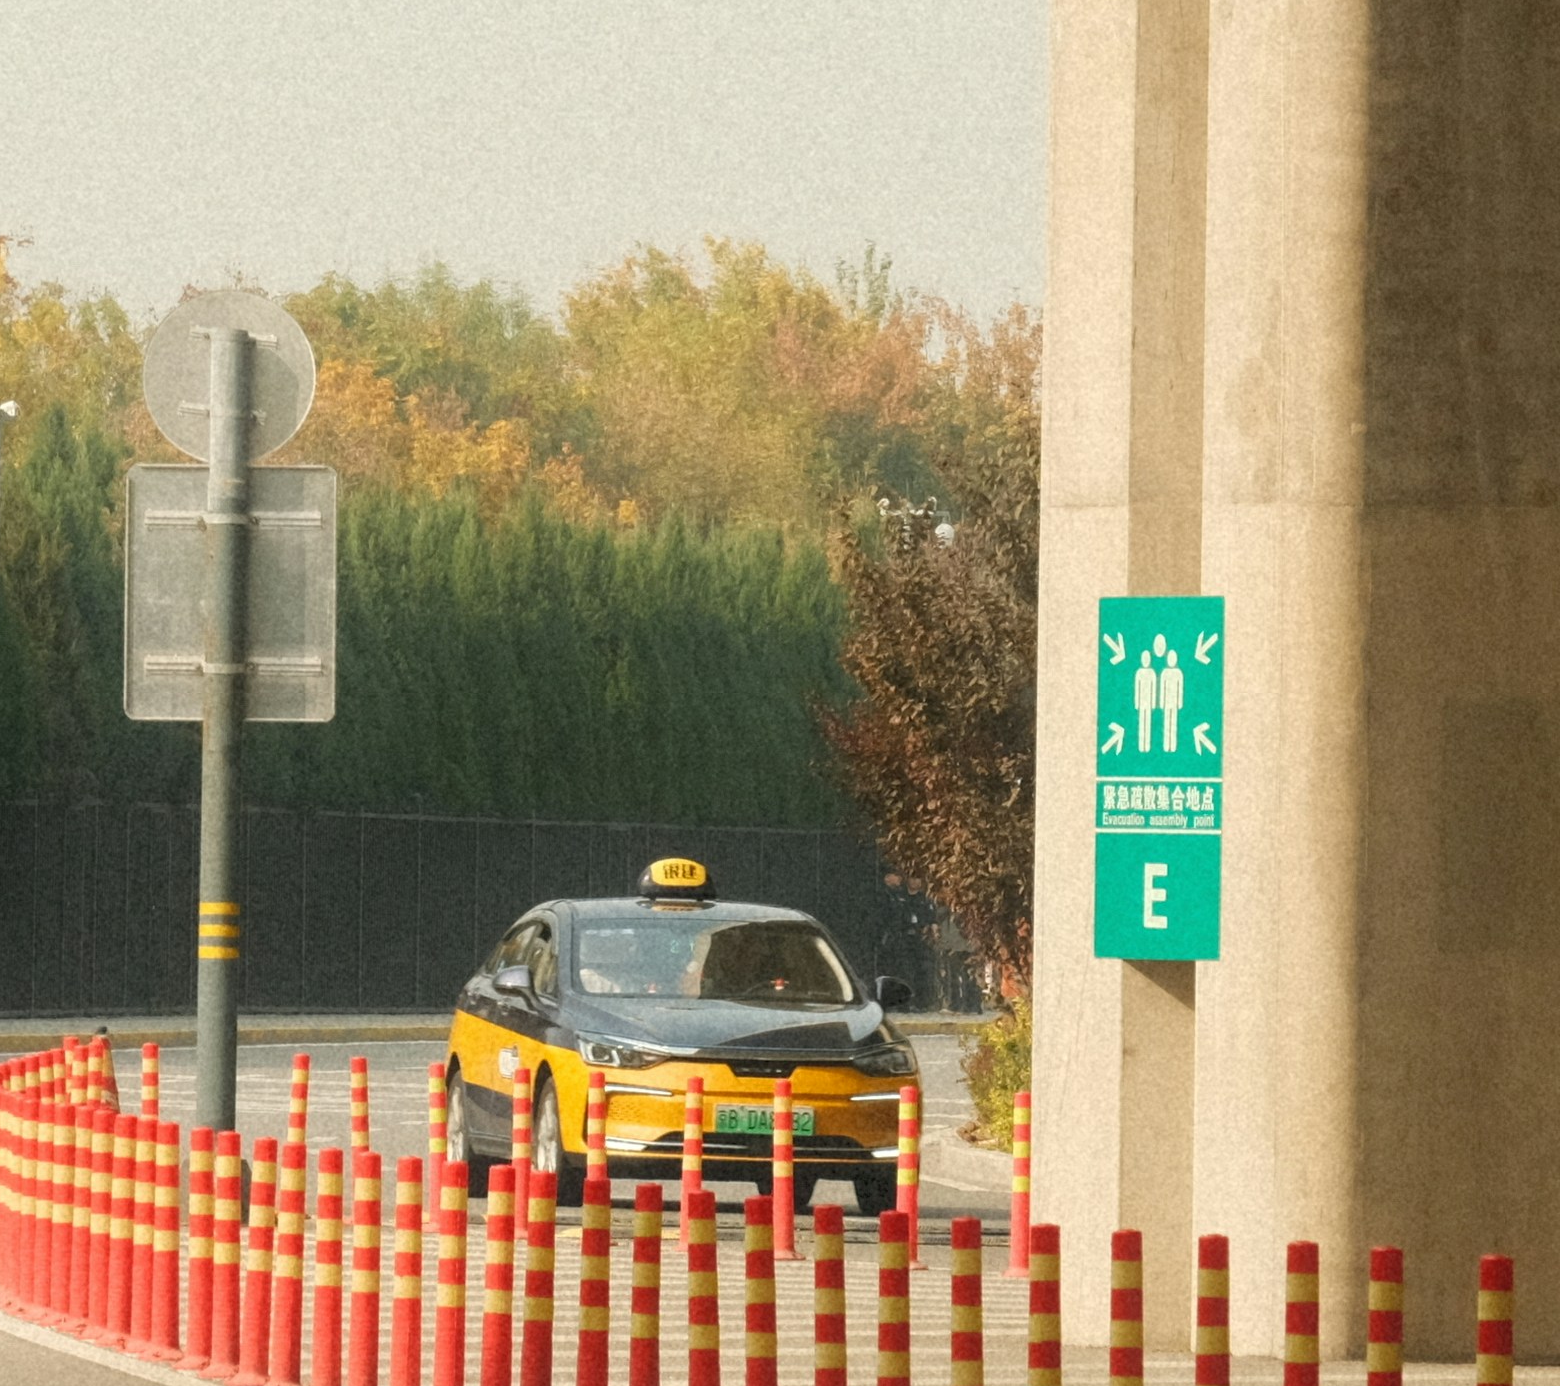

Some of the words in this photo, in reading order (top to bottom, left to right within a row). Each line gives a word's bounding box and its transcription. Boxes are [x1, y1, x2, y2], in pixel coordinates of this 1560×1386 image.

[1103, 785, 1215, 811] 紧急疏散集合地点
[1102, 812, 1145, 826] Evacuation
[1149, 813, 1188, 829] assembly
[1193, 813, 1215, 829] point
[1143, 863, 1168, 929] E
